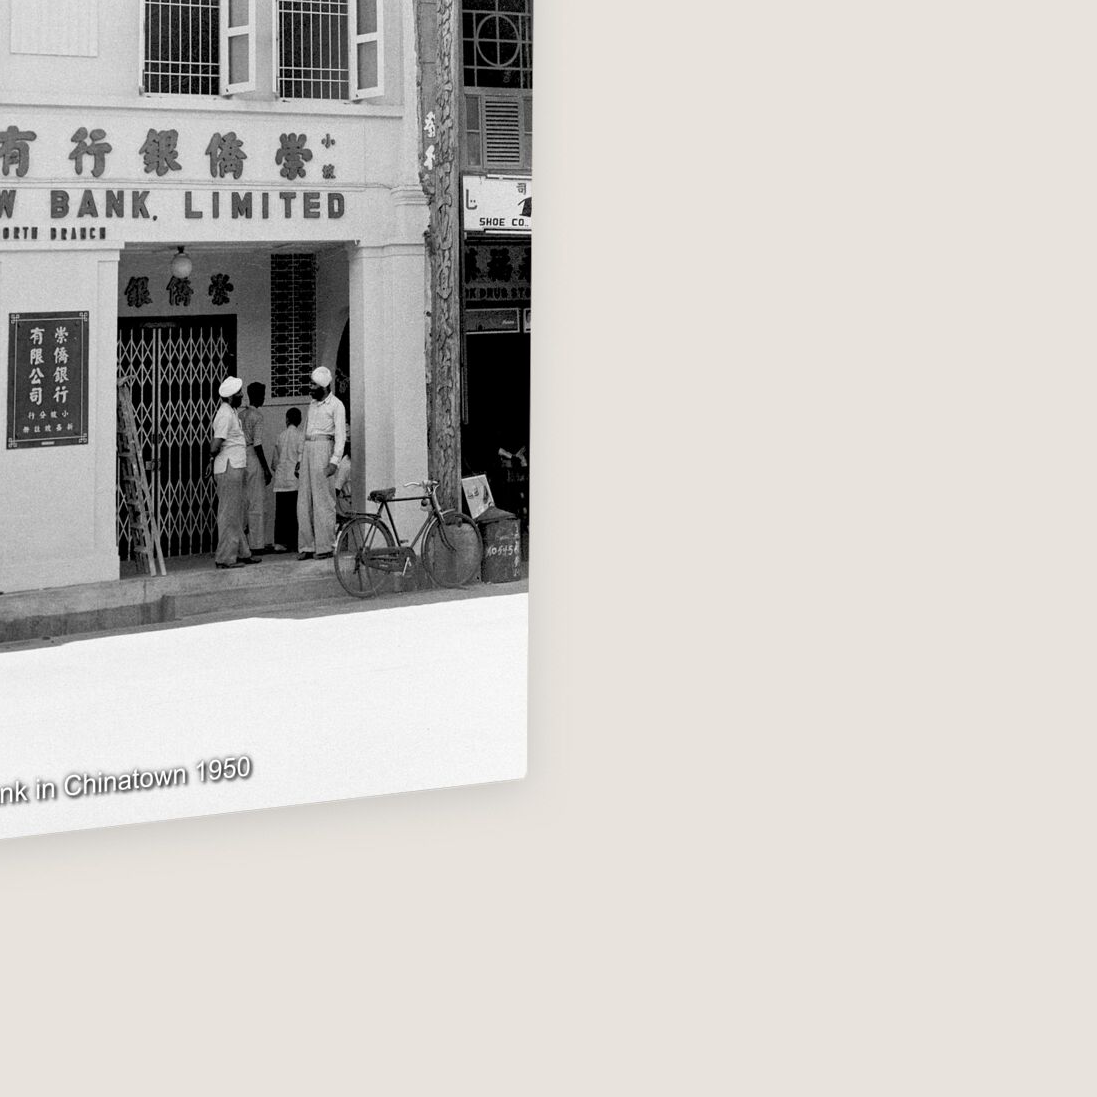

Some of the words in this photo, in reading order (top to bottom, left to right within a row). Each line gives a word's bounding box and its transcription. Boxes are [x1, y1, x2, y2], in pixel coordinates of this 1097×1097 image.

[184, 190, 346, 220] LIMITED
[479, 217, 505, 227] SHOE
[50, 227, 106, 241] BRANCH
[479, 287, 509, 300] DRUG
[28, 326, 45, 406] 有限公司
[53, 326, 70, 404] 崇僑銀行
